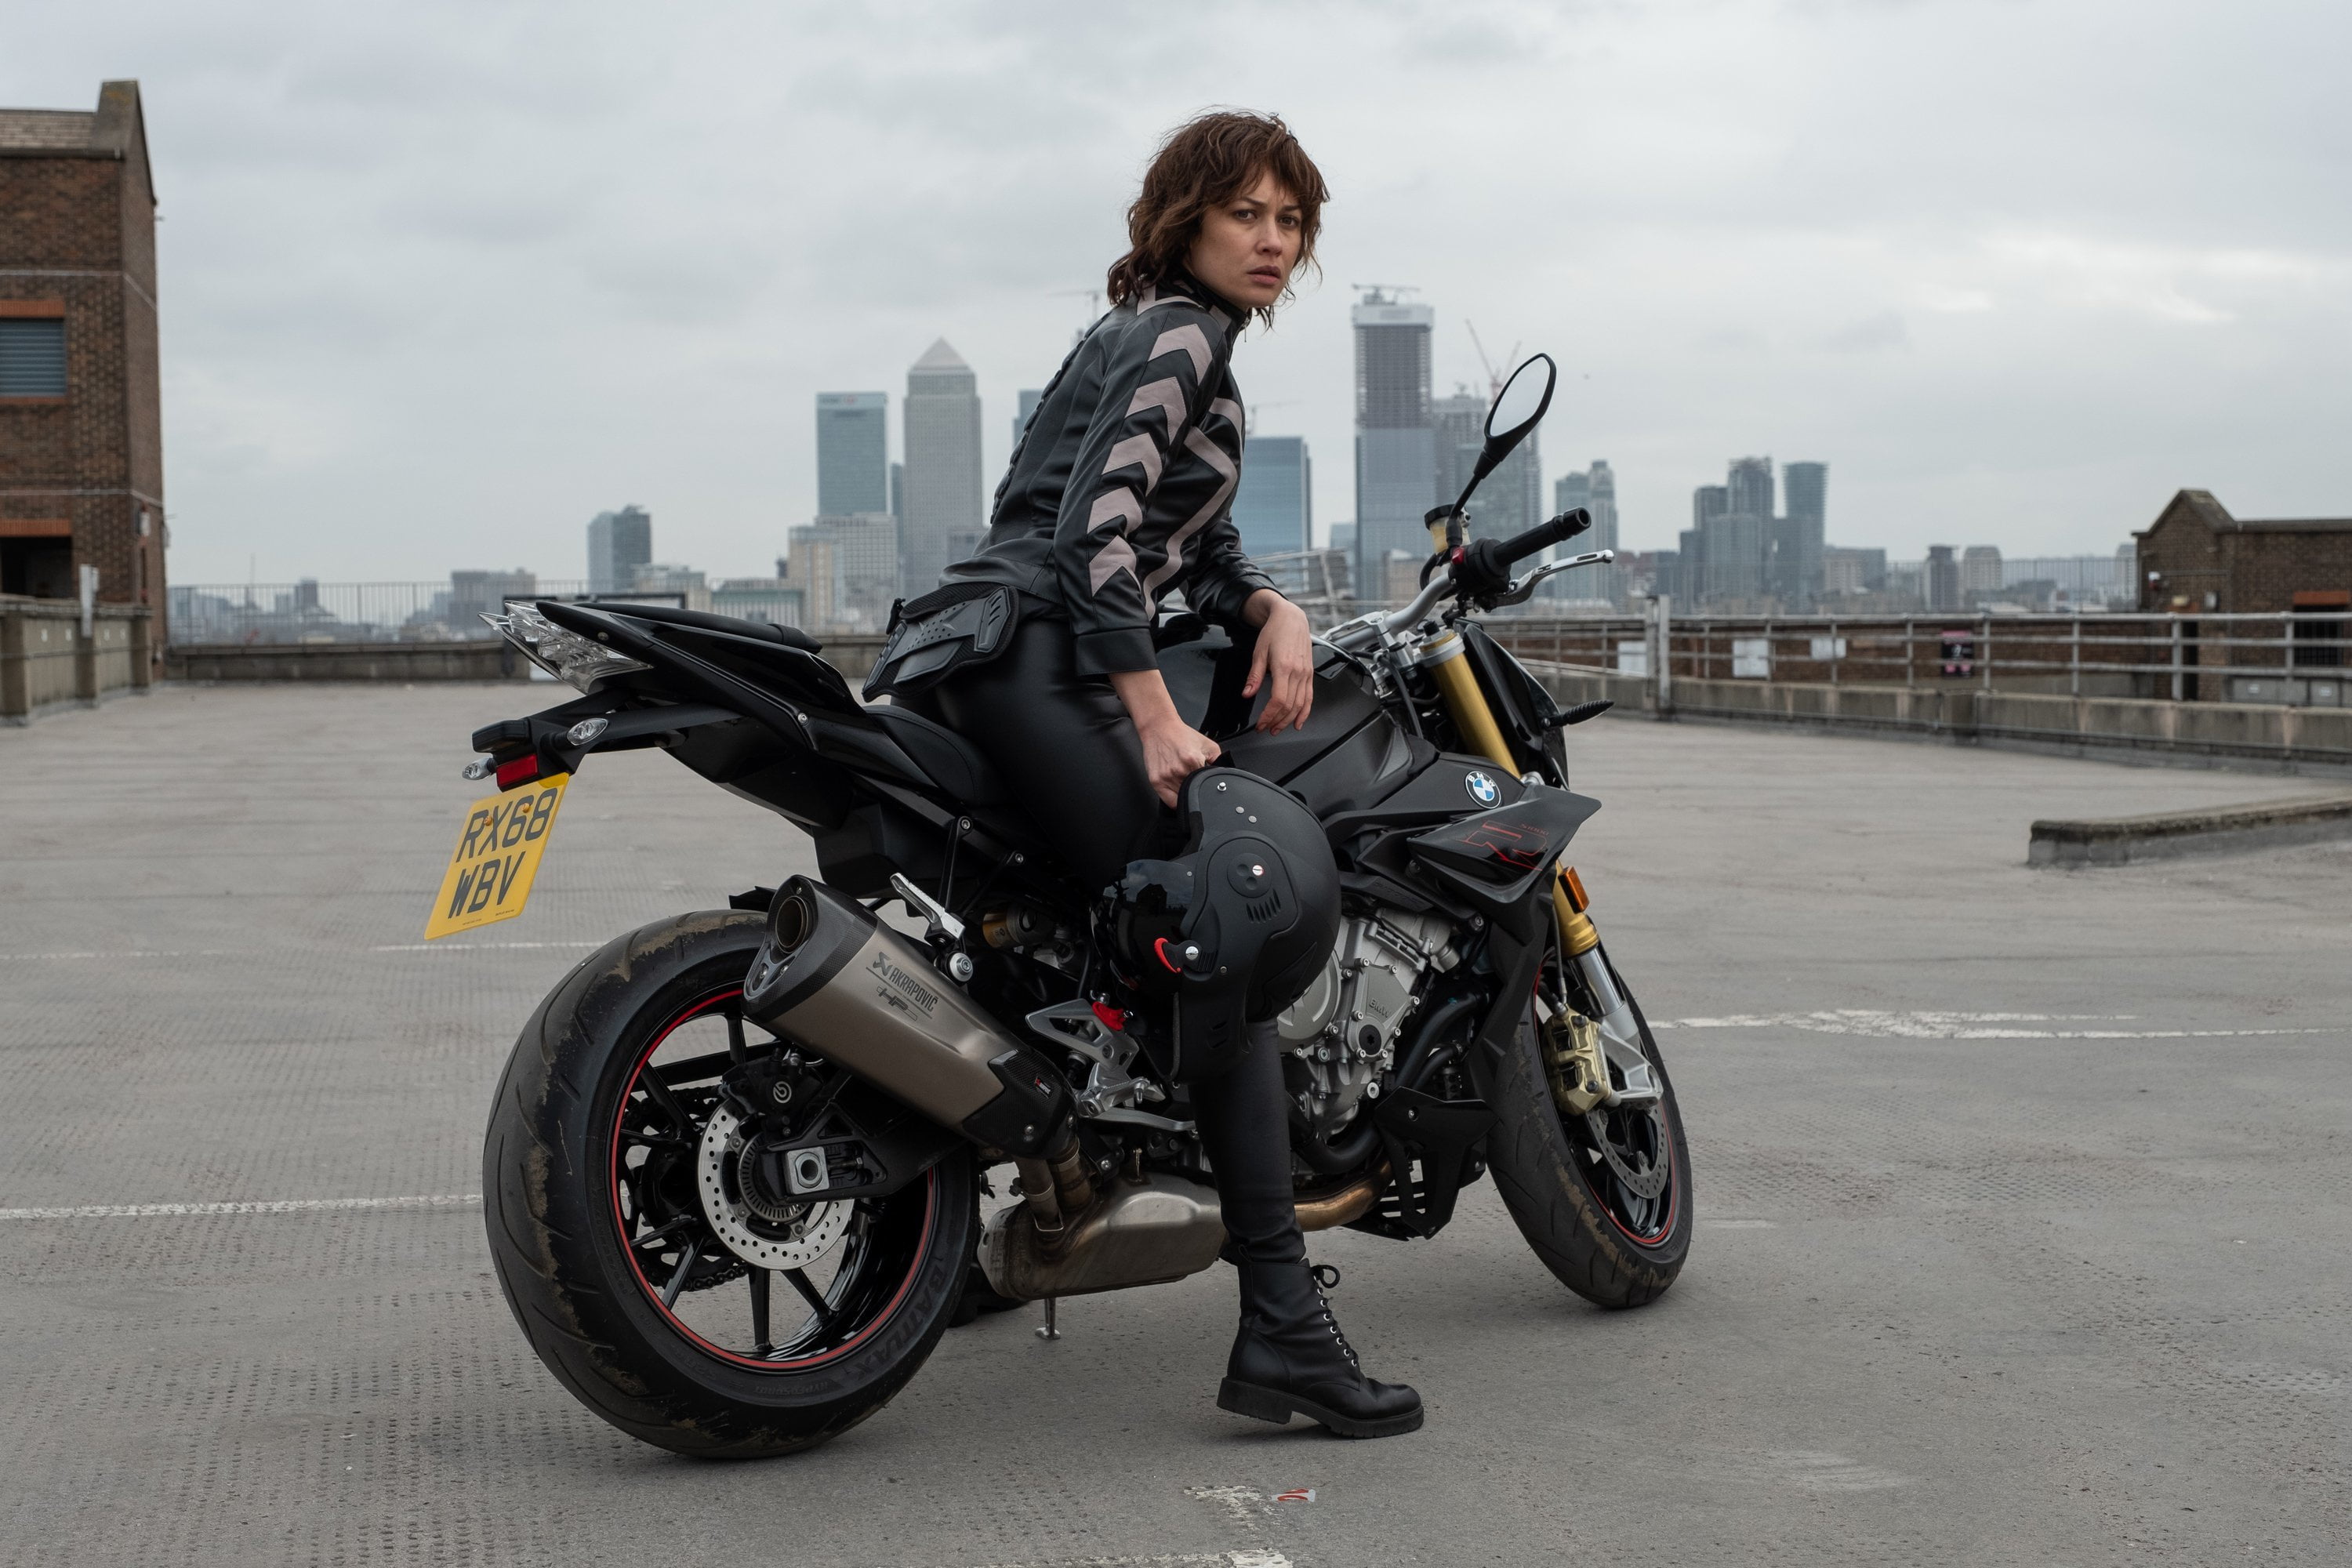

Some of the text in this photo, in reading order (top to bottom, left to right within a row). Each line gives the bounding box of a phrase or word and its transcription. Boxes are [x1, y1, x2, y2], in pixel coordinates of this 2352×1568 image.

[1468, 771, 1496, 787] BMW
[456, 787, 558, 863] RX68
[448, 851, 526, 919] WBV
[888, 967, 938, 1012] AKRAPOVIČ
[1369, 997, 1388, 1018] BMW
